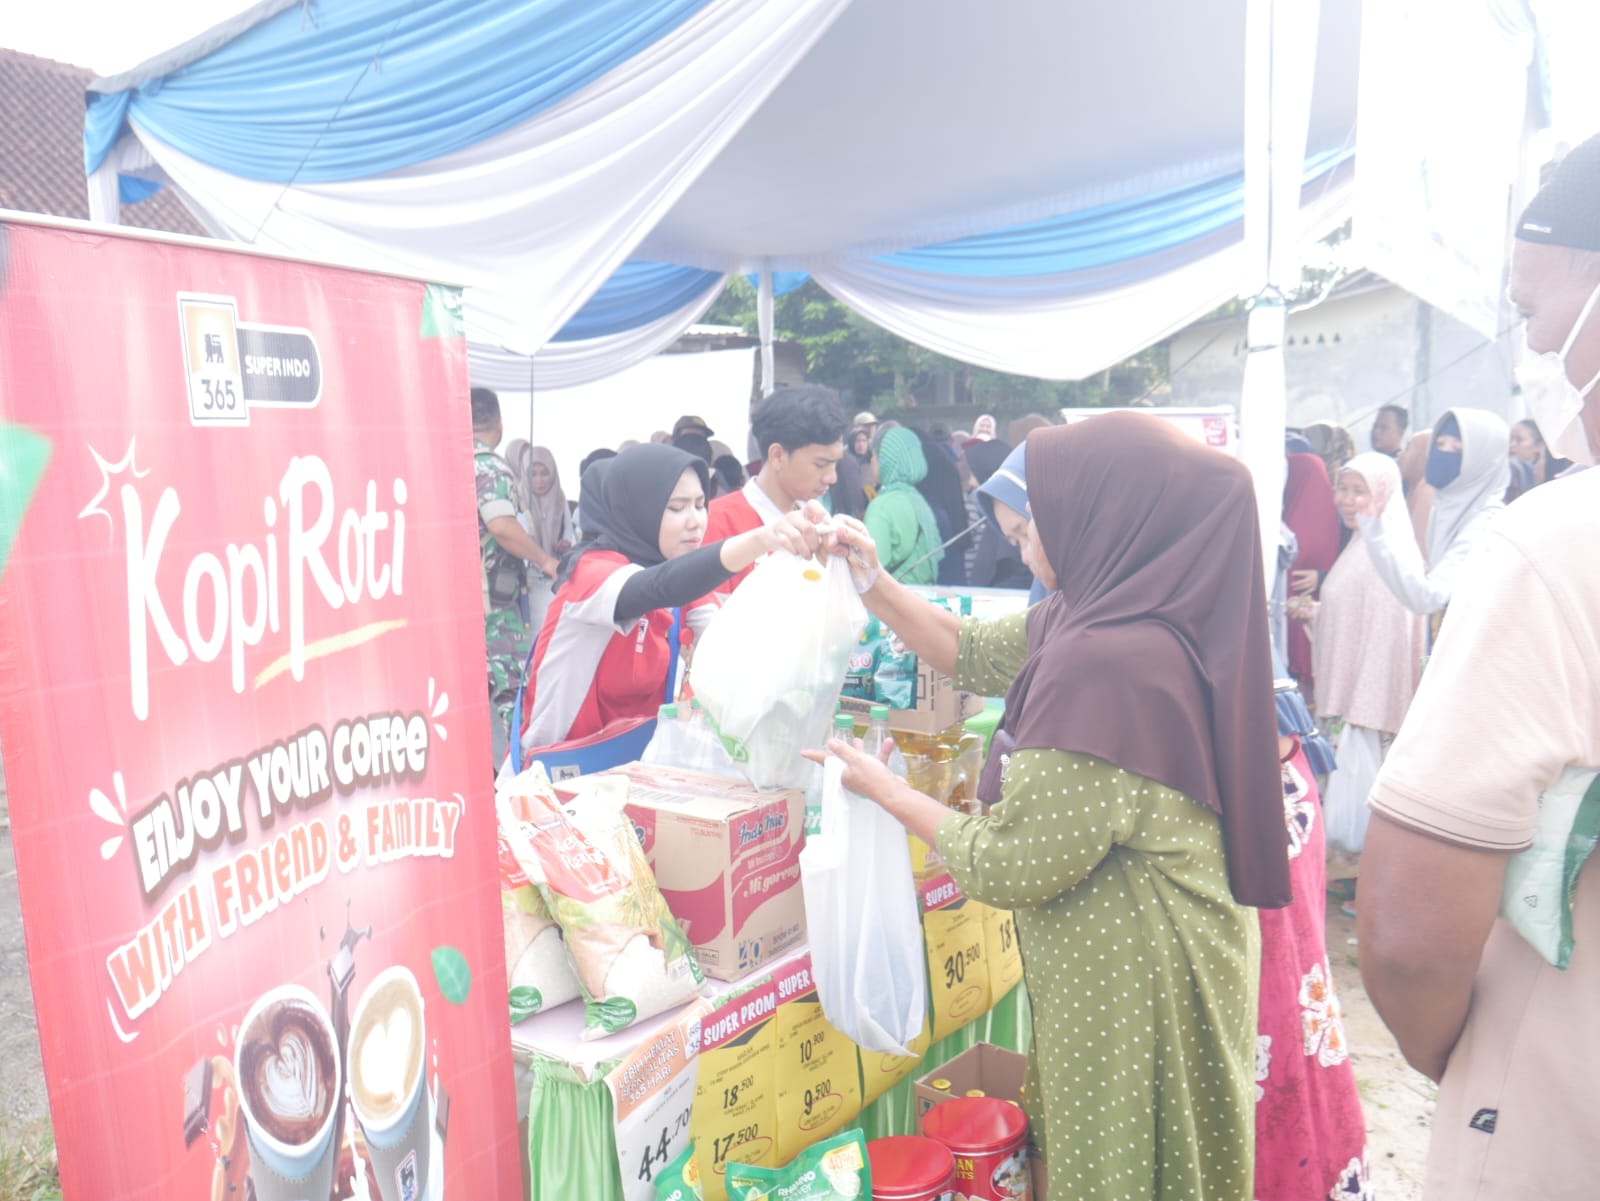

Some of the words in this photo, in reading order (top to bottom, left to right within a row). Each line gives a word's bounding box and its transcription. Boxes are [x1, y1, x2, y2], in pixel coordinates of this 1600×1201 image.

[201, 379, 236, 410] 365
[121, 484, 280, 720] Kopi
[279, 455, 407, 682] Roti
[132, 765, 242, 893] ENJOY
[248, 730, 330, 818] YOUR
[108, 883, 207, 1012] WITH
[338, 814, 357, 864] &
[366, 801, 459, 856] FAMILY
[926, 882, 954, 907] SUPER
[779, 969, 810, 998] SUPER
[704, 1011, 739, 1045] SUPER
